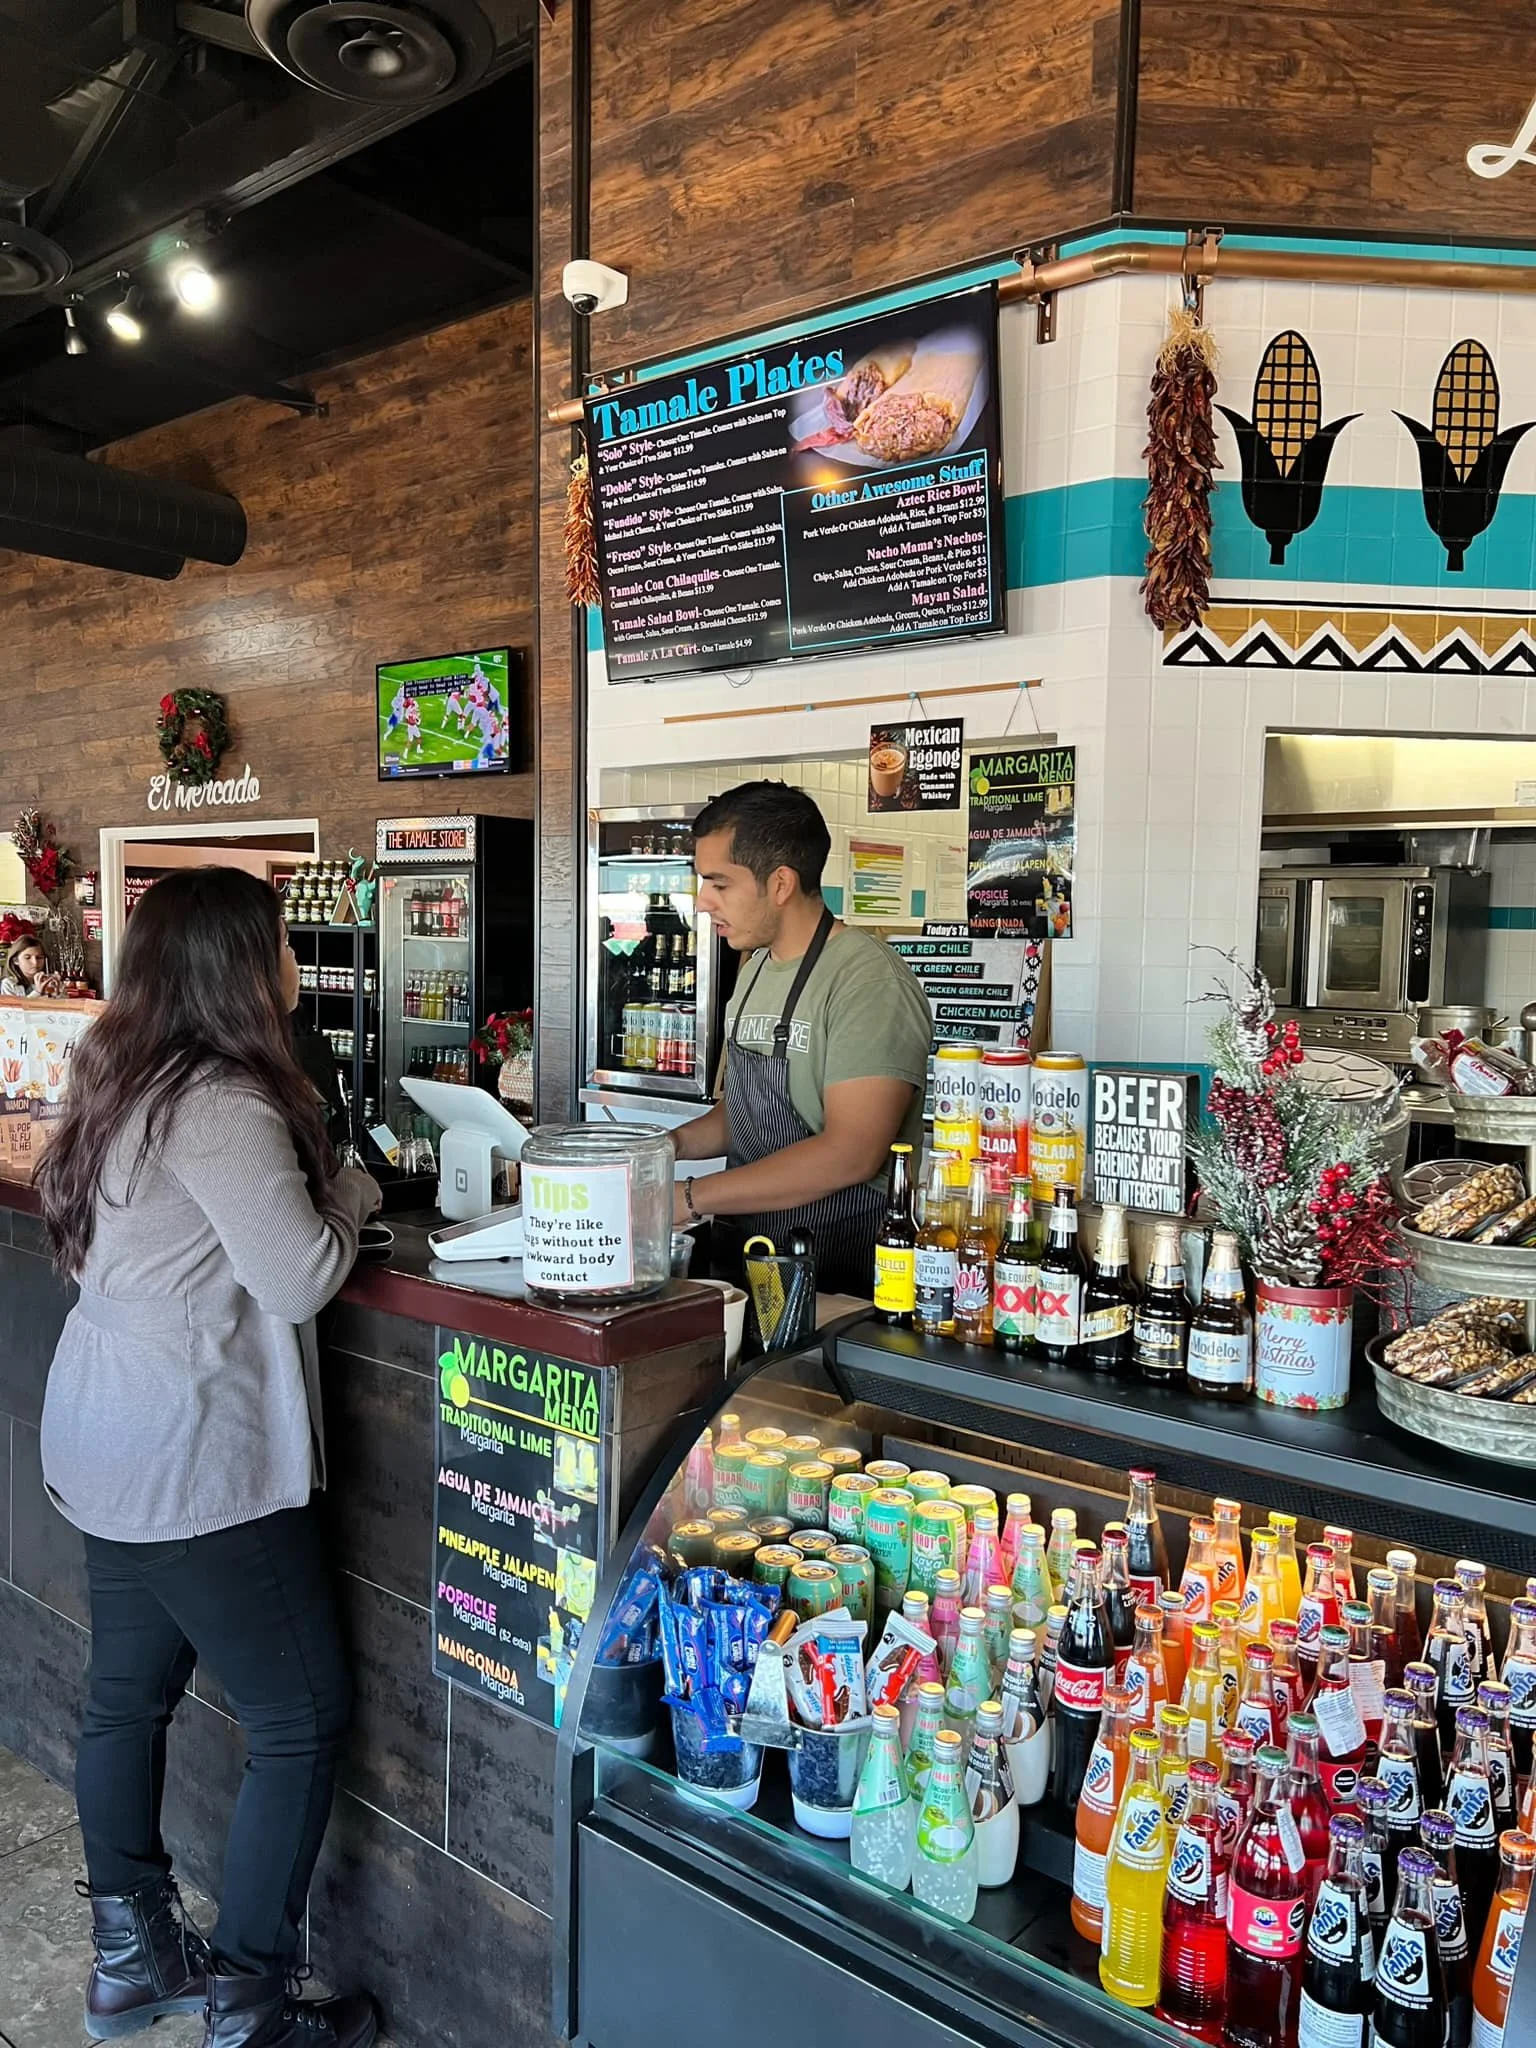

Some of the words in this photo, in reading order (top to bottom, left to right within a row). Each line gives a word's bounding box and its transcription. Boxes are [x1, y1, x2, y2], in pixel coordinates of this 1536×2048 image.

[594, 378, 718, 441] Tamale
[725, 348, 844, 407] Plates
[629, 440, 656, 457] Style-
[639, 471, 666, 490] Style-
[812, 488, 858, 511] Other
[861, 472, 936, 500] Awesome
[939, 457, 984, 484] Stuff
[897, 494, 925, 509] Aztec
[927, 489, 950, 501] Rice
[952, 481, 985, 497] Bowl-
[649, 507, 674, 523] Style-
[879, 524, 897, 537] (Add
[898, 524, 904, 532] A
[906, 518, 931, 530] Tamale
[943, 514, 957, 524] Top
[959, 512, 972, 520] For
[972, 508, 985, 518] $5)
[648, 541, 674, 558] Style-
[867, 546, 899, 560] Nacho
[901, 538, 942, 555] Mama's
[944, 532, 986, 547] Nachos-
[609, 583, 643, 598] Tamale
[645, 580, 664, 591] Con
[723, 569, 745, 577] Choose
[888, 582, 902, 592] Add
[903, 582, 909, 590] A
[911, 577, 936, 588] Tamale
[948, 574, 962, 583] Top
[964, 571, 976, 580] For
[976, 568, 987, 578] $5
[912, 589, 950, 609] Mayan
[953, 582, 988, 600] Salad-
[613, 616, 646, 631] Tamale
[648, 611, 673, 625] Salad
[676, 607, 702, 621] Bowl-
[616, 651, 648, 664] Tamale
[651, 649, 658, 660] A
[661, 647, 673, 658] La
[676, 644, 700, 656] Cart-
[714, 642, 735, 651] Tamale
[736, 639, 752, 648] $4.99
[904, 727, 960, 747] Mexican
[909, 748, 960, 771] Eggnog
[979, 752, 1073, 777] MARGARITA
[919, 773, 938, 781] Made
[939, 772, 956, 780] with
[1038, 768, 1073, 784] MENU
[148, 773, 171, 811] El
[921, 792, 951, 801] Whiskey
[970, 794, 1020, 807] TRADITIONAL
[1023, 791, 1044, 803] LIME
[983, 802, 1013, 814] Margarita
[387, 832, 403, 849] THE
[404, 831, 438, 848] TAMALE
[439, 829, 465, 848] STORE
[969, 829, 990, 840] AGUA
[992, 828, 1004, 839] DE
[969, 889, 1009, 900] POPSICLE
[926, 924, 958, 937] Today's
[969, 918, 1025, 928] MANGONADA
[916, 944, 936, 954] RED
[939, 943, 969, 954] CHILE
[923, 963, 952, 973] GREEN
[954, 964, 980, 974] CHILE
[924, 985, 956, 994] CHICKEN
[958, 986, 985, 995] GREEN
[986, 987, 1009, 996] CHILE
[940, 1006, 986, 1018] CHICKEN
[989, 1007, 1022, 1020] MOLE
[935, 1023, 950, 1035] EX
[952, 1025, 976, 1037] MEX
[935, 1075, 976, 1097] odelo
[980, 1082, 1021, 1103] odelo
[1094, 1074, 1184, 1130] BEER
[1095, 1123, 1147, 1152] BECAUSE
[1149, 1129, 1181, 1157] YOUR
[1094, 1150, 1139, 1181] FRIENDS
[1140, 1154, 1181, 1185] AREN'T
[530, 1175, 590, 1214] Tips
[1094, 1177, 1118, 1203] THAT
[1119, 1180, 1181, 1213] INTERESTING
[529, 1216, 572, 1232] They're
[576, 1219, 604, 1231] like
[543, 1236, 595, 1248] without
[599, 1235, 622, 1246] the
[579, 1252, 615, 1266] body
[540, 1271, 588, 1283] contact
[1008, 1272, 1033, 1283] EQUIS
[1259, 1322, 1307, 1353] Merry
[453, 1337, 600, 1415] MARGARITA
[544, 1397, 599, 1436] MENU
[439, 1403, 516, 1446] TRADITIONAL
[520, 1430, 553, 1458] LIME
[460, 1427, 504, 1455] Margarita
[438, 1466, 471, 1496] AGUA
[474, 1480, 492, 1501] DE
[494, 1487, 550, 1526] JAMAICA
[471, 1495, 515, 1528] Margarita
[438, 1526, 501, 1567] PINEAPPLE
[502, 1553, 565, 1594] JALAPENO
[482, 1562, 528, 1594] Margarita
[438, 1581, 497, 1623] POPSICLE
[453, 1604, 497, 1636] Margarita
[499, 1627, 512, 1644] ($2
[512, 1635, 532, 1655] extra)
[1298, 1608, 1321, 1637] anta
[438, 1633, 519, 1688] MANGONADA
[480, 1671, 525, 1706] Margarita
[1450, 1785, 1489, 1830] Fanta
[1124, 1809, 1161, 1850] Fanta
[1312, 1900, 1348, 1938] Fanta
[1436, 1894, 1460, 1937] anta
[1382, 1938, 1423, 1980] Fanta
